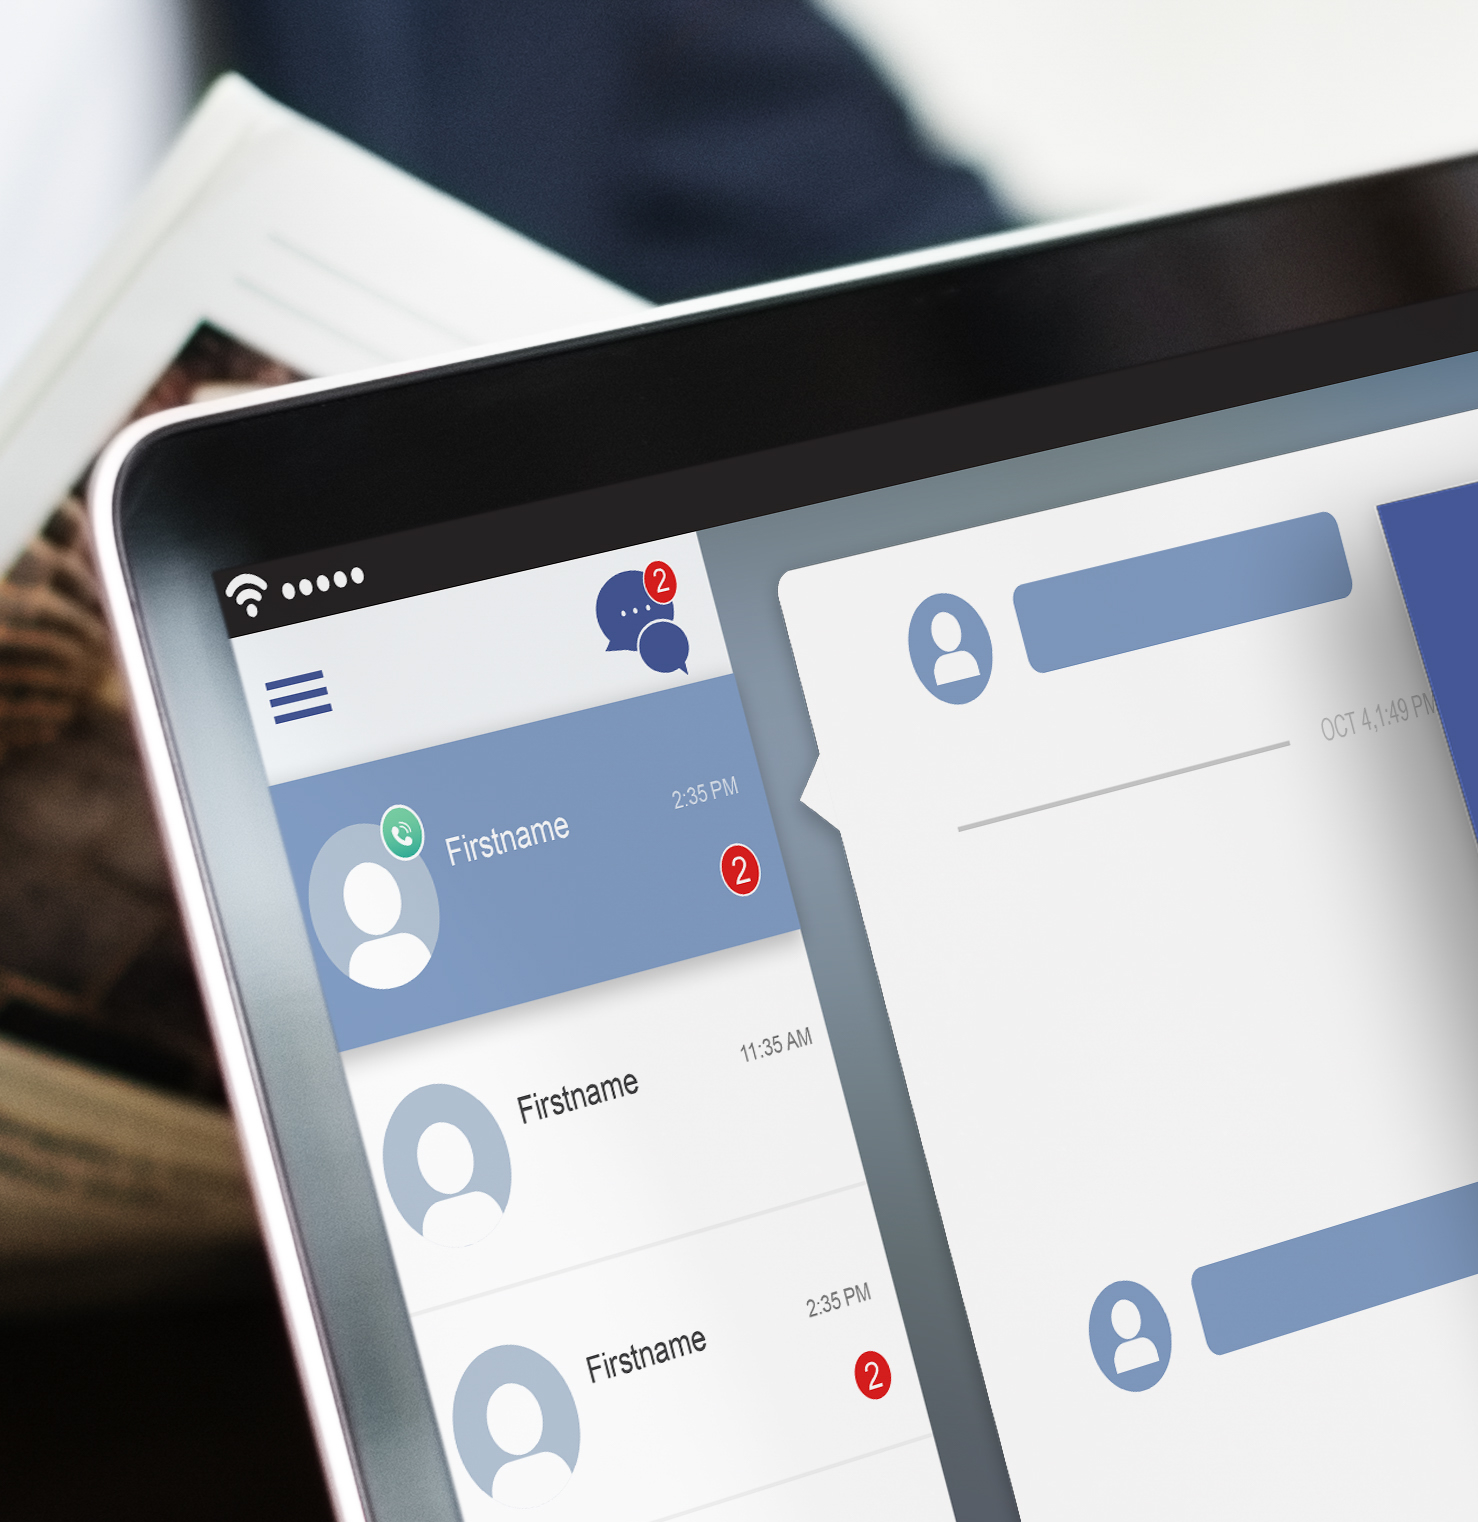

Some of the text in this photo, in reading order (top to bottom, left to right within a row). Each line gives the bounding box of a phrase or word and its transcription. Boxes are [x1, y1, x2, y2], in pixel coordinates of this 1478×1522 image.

[652, 567, 670, 593] 2
[1321, 711, 1356, 741] OCT
[672, 776, 739, 809] 2:35 PM
[444, 816, 571, 867] Firstname
[731, 856, 752, 886] 2
[740, 1026, 813, 1062] 11:35 AM
[516, 1072, 640, 1125] Firstname
[806, 1281, 872, 1318] 2:35 PM
[585, 1330, 708, 1384] Firstname
[863, 1362, 883, 1391] 2
